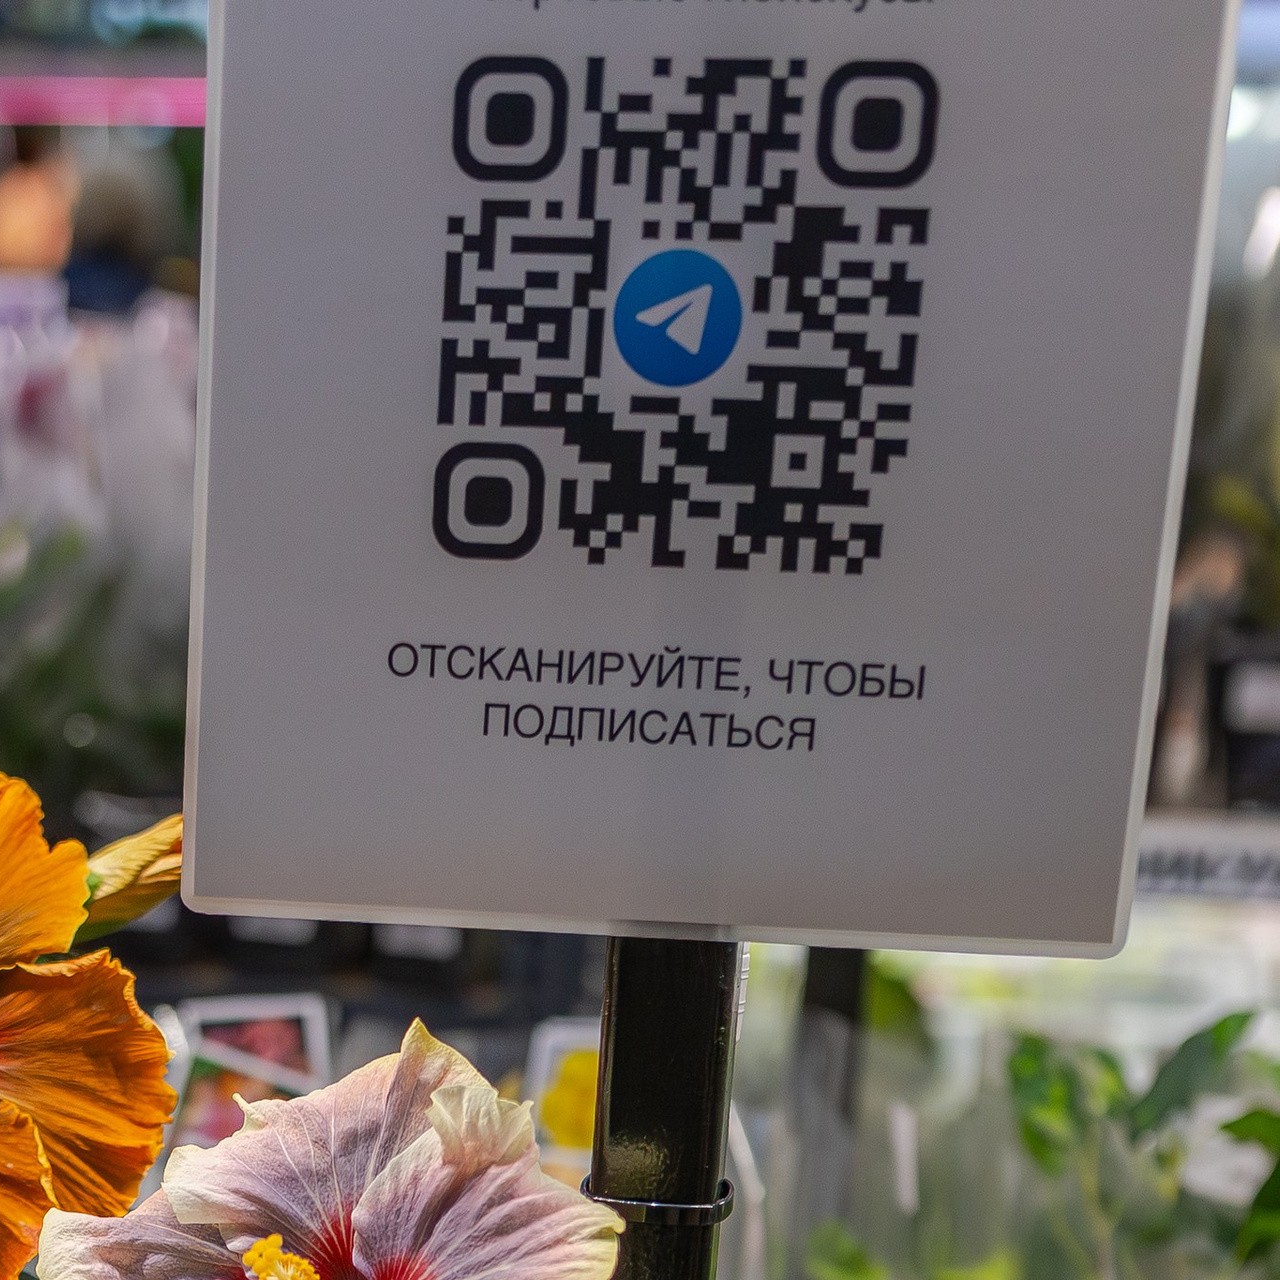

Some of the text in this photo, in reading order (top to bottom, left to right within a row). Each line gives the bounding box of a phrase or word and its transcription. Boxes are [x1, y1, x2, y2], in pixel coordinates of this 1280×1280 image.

[387, 642, 926, 699] ОТСКАНИРУЙТЕ, ЧТОБЫ
[482, 702, 817, 752] ПОДПИСАТЬСЯ
